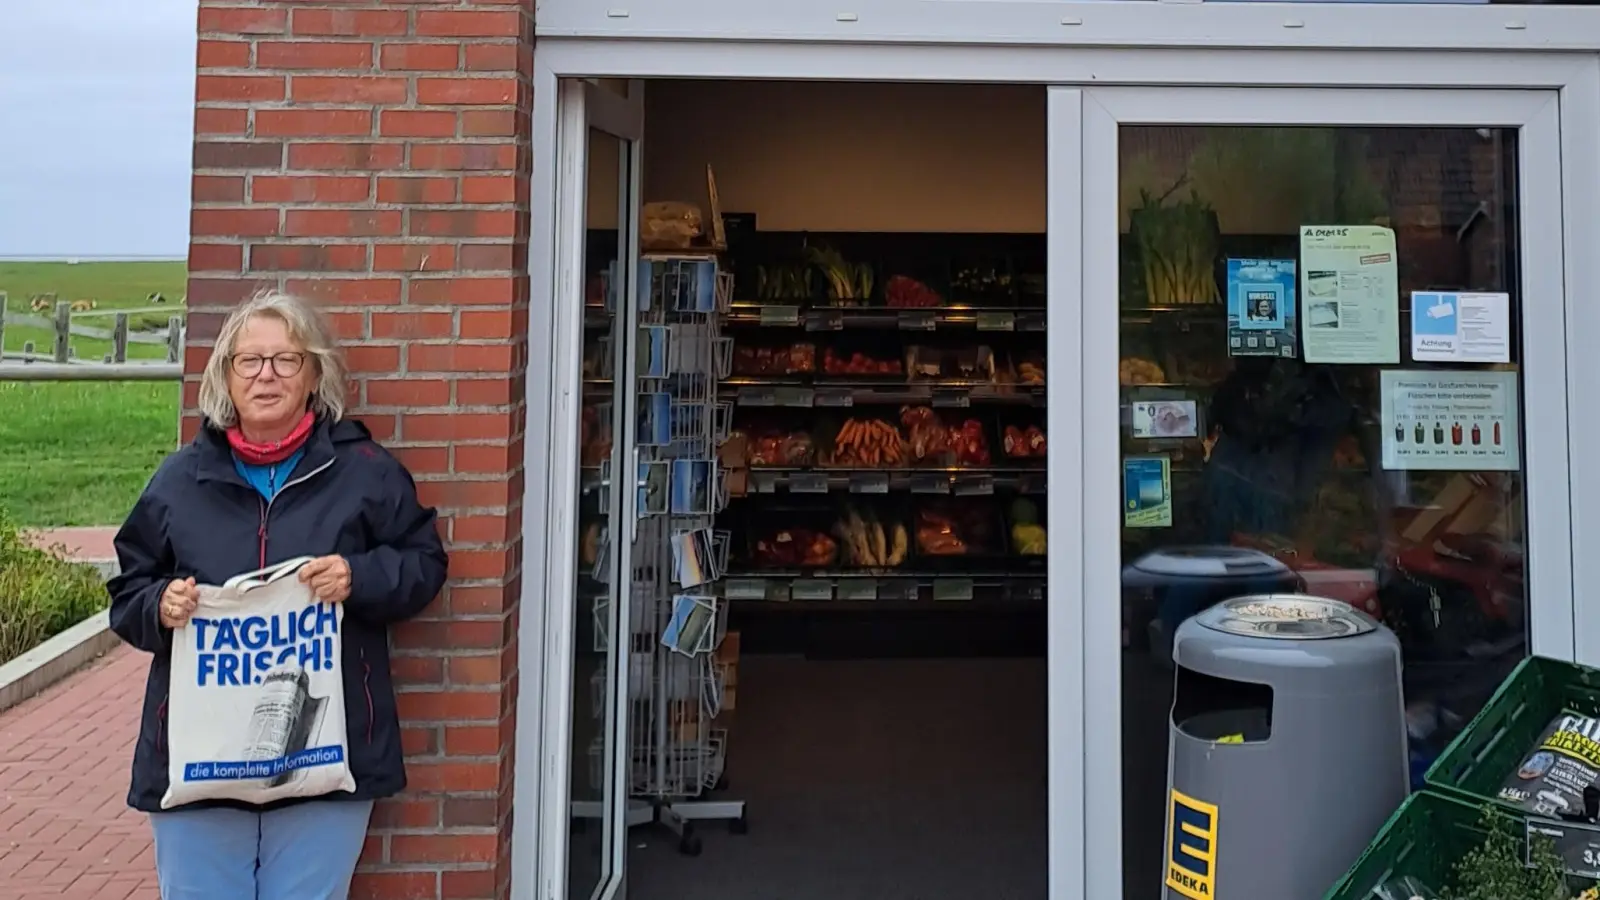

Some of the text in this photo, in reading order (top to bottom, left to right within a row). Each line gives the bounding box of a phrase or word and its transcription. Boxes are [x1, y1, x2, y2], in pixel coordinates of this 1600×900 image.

[1421, 338, 1452, 348] Achtung
[192, 602, 338, 651] TÄGLICH
[190, 763, 210, 779] die
[213, 760, 270, 780] komplette
[274, 748, 338, 774] Information
[1170, 868, 1209, 895] EDEKA
